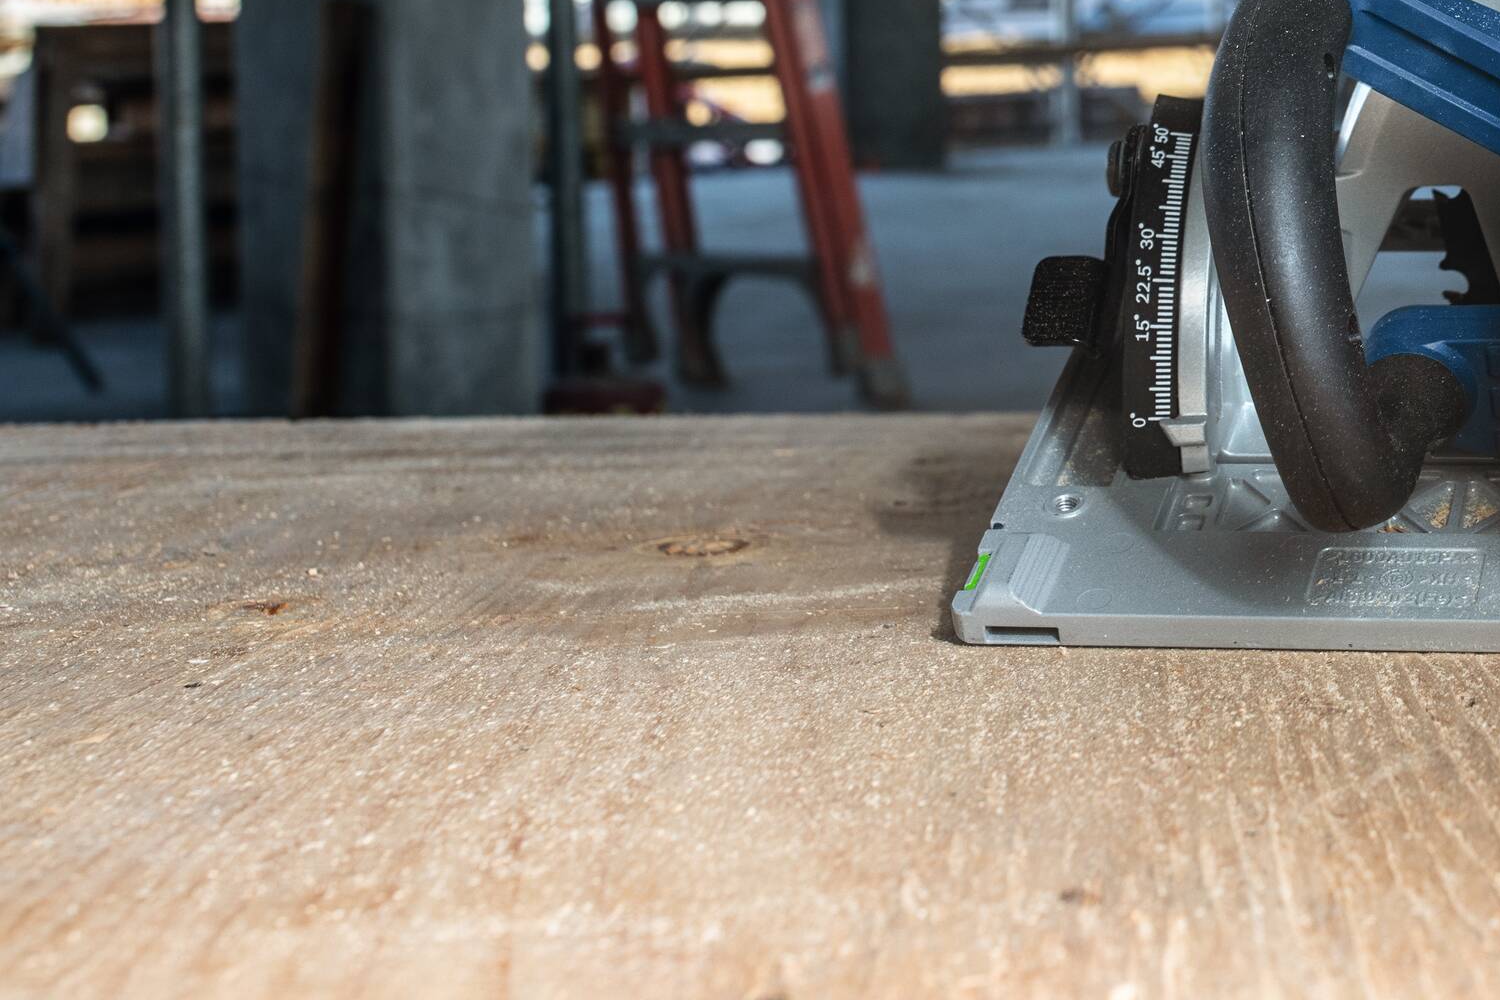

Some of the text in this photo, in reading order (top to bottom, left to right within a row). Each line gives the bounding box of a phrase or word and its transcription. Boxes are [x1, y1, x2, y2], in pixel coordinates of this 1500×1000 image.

[1153, 123, 1169, 144] 50°
[1150, 145, 1166, 169] 45°
[1138, 222, 1155, 250] 30°
[1135, 259, 1152, 304] 22.5°
[1133, 314, 1150, 342] 15°
